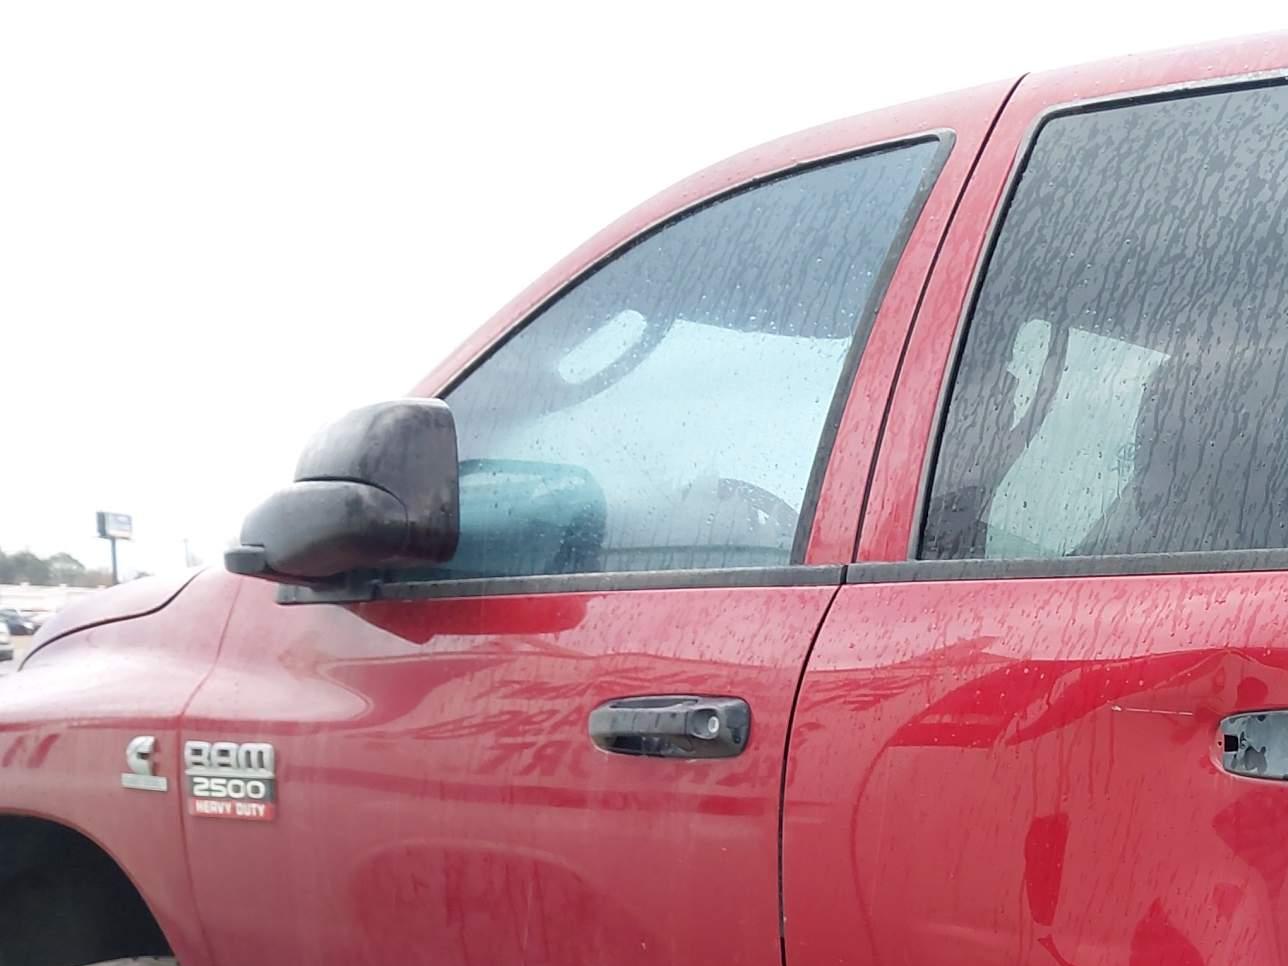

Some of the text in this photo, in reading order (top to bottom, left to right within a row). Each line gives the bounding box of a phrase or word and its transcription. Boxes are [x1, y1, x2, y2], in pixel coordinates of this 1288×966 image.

[184, 740, 275, 772] RAM
[192, 776, 266, 799] 2500
[195, 800, 266, 817] HEAVY DUTY
